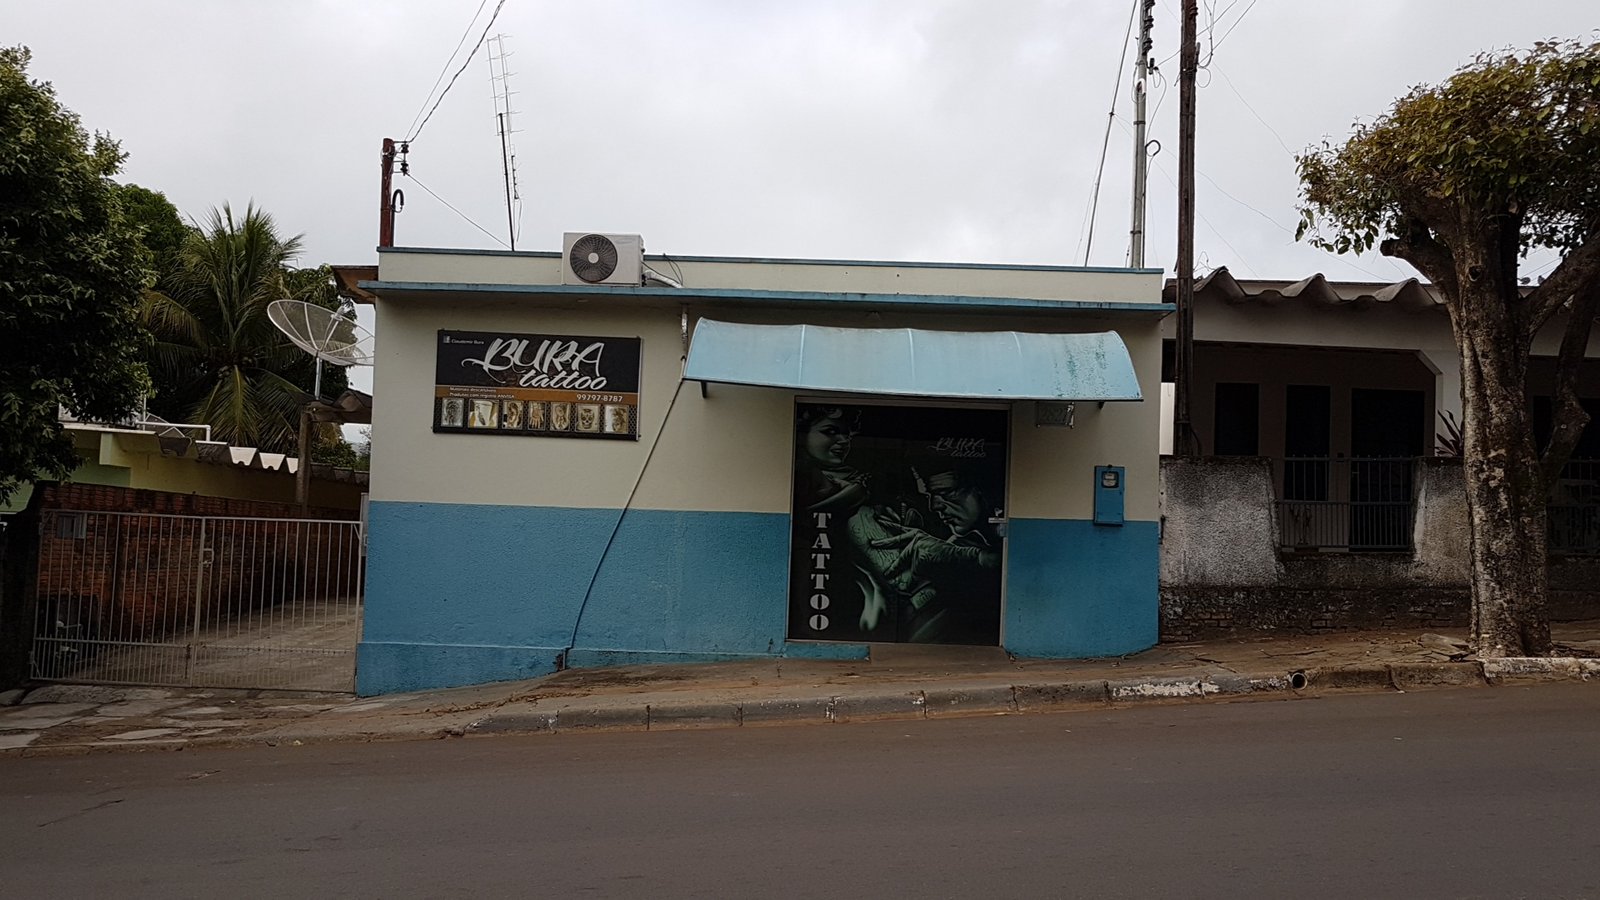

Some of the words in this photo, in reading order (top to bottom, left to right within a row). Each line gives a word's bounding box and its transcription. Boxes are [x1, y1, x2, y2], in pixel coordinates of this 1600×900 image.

[461, 338, 605, 384] BURA
[519, 369, 608, 390] tattoo
[576, 393, 623, 403] 99797-8787
[808, 512, 832, 631] TATTOO
